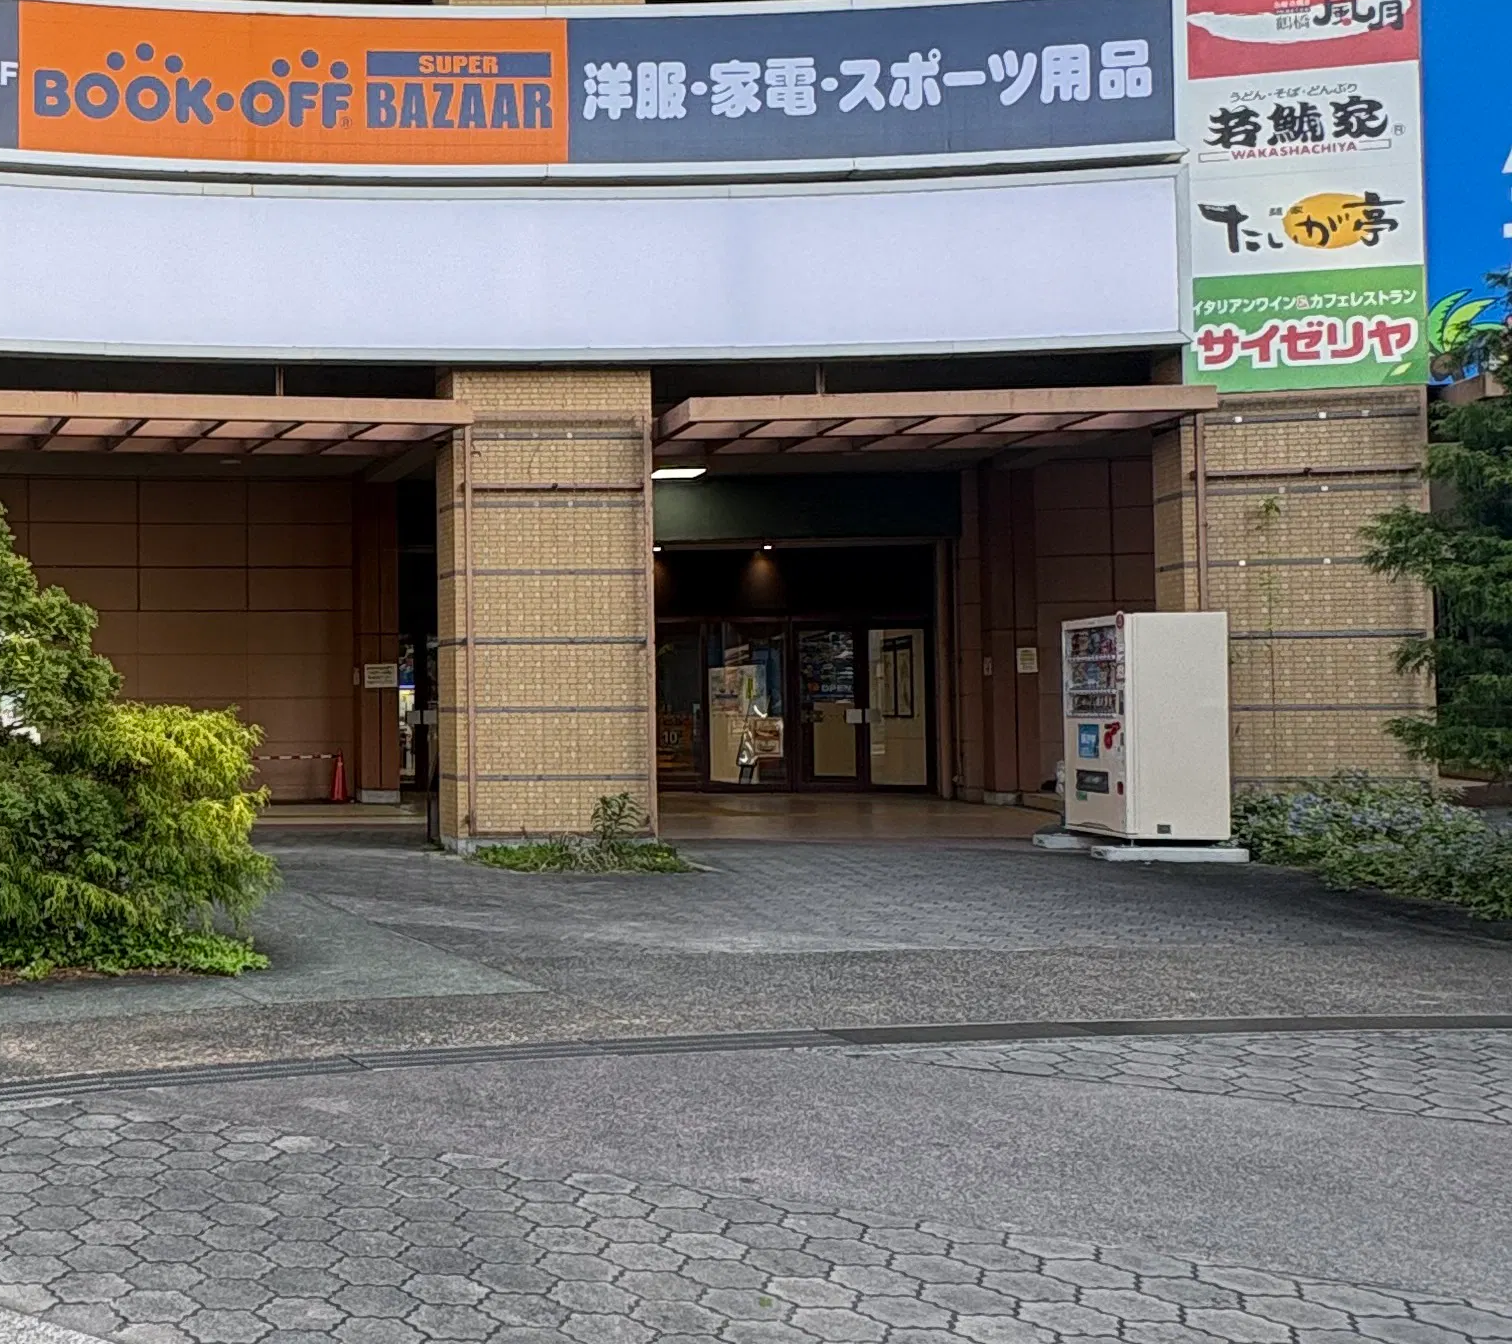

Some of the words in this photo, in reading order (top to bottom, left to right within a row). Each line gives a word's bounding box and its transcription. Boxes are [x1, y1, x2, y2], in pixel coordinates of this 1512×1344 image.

[418, 54, 499, 75] SUPER
[582, 38, 1153, 121] 洋服・家電・スポーツ用品
[366, 82, 553, 130] BAZAAR
[1231, 141, 1358, 160] WAKASHACHIYA
[1193, 289, 1417, 316] イタリアンワイン&カフェレストラン
[1194, 318, 1414, 367] サイゼリヤ
